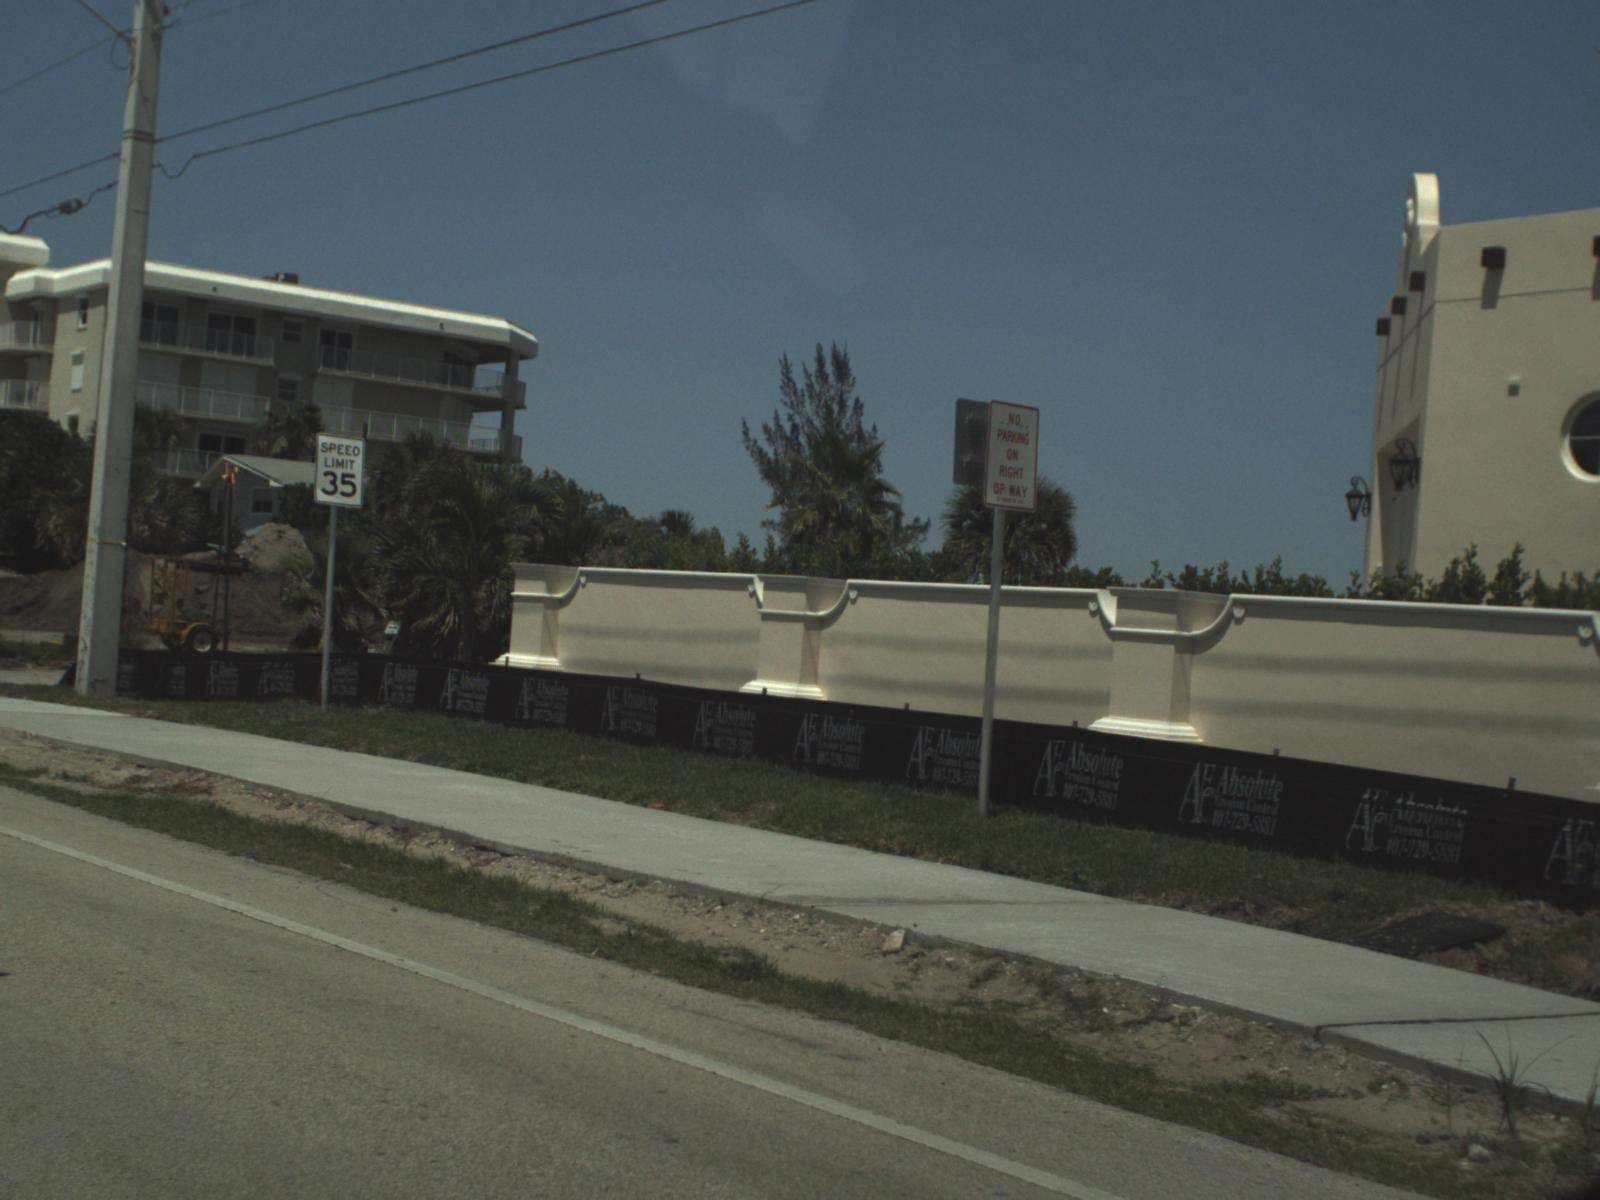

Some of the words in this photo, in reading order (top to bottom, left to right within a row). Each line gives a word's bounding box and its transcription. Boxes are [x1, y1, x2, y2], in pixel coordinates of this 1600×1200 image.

[1008, 413, 1021, 426] NO
[997, 430, 1029, 446] PARKING
[321, 442, 360, 456] SPEED
[1007, 448, 1018, 461] ON
[324, 457, 355, 470] LIMIT
[999, 465, 1024, 480] RIGHT
[321, 471, 357, 497] 35
[993, 482, 1006, 496] OF
[1008, 484, 1028, 498] WAY
